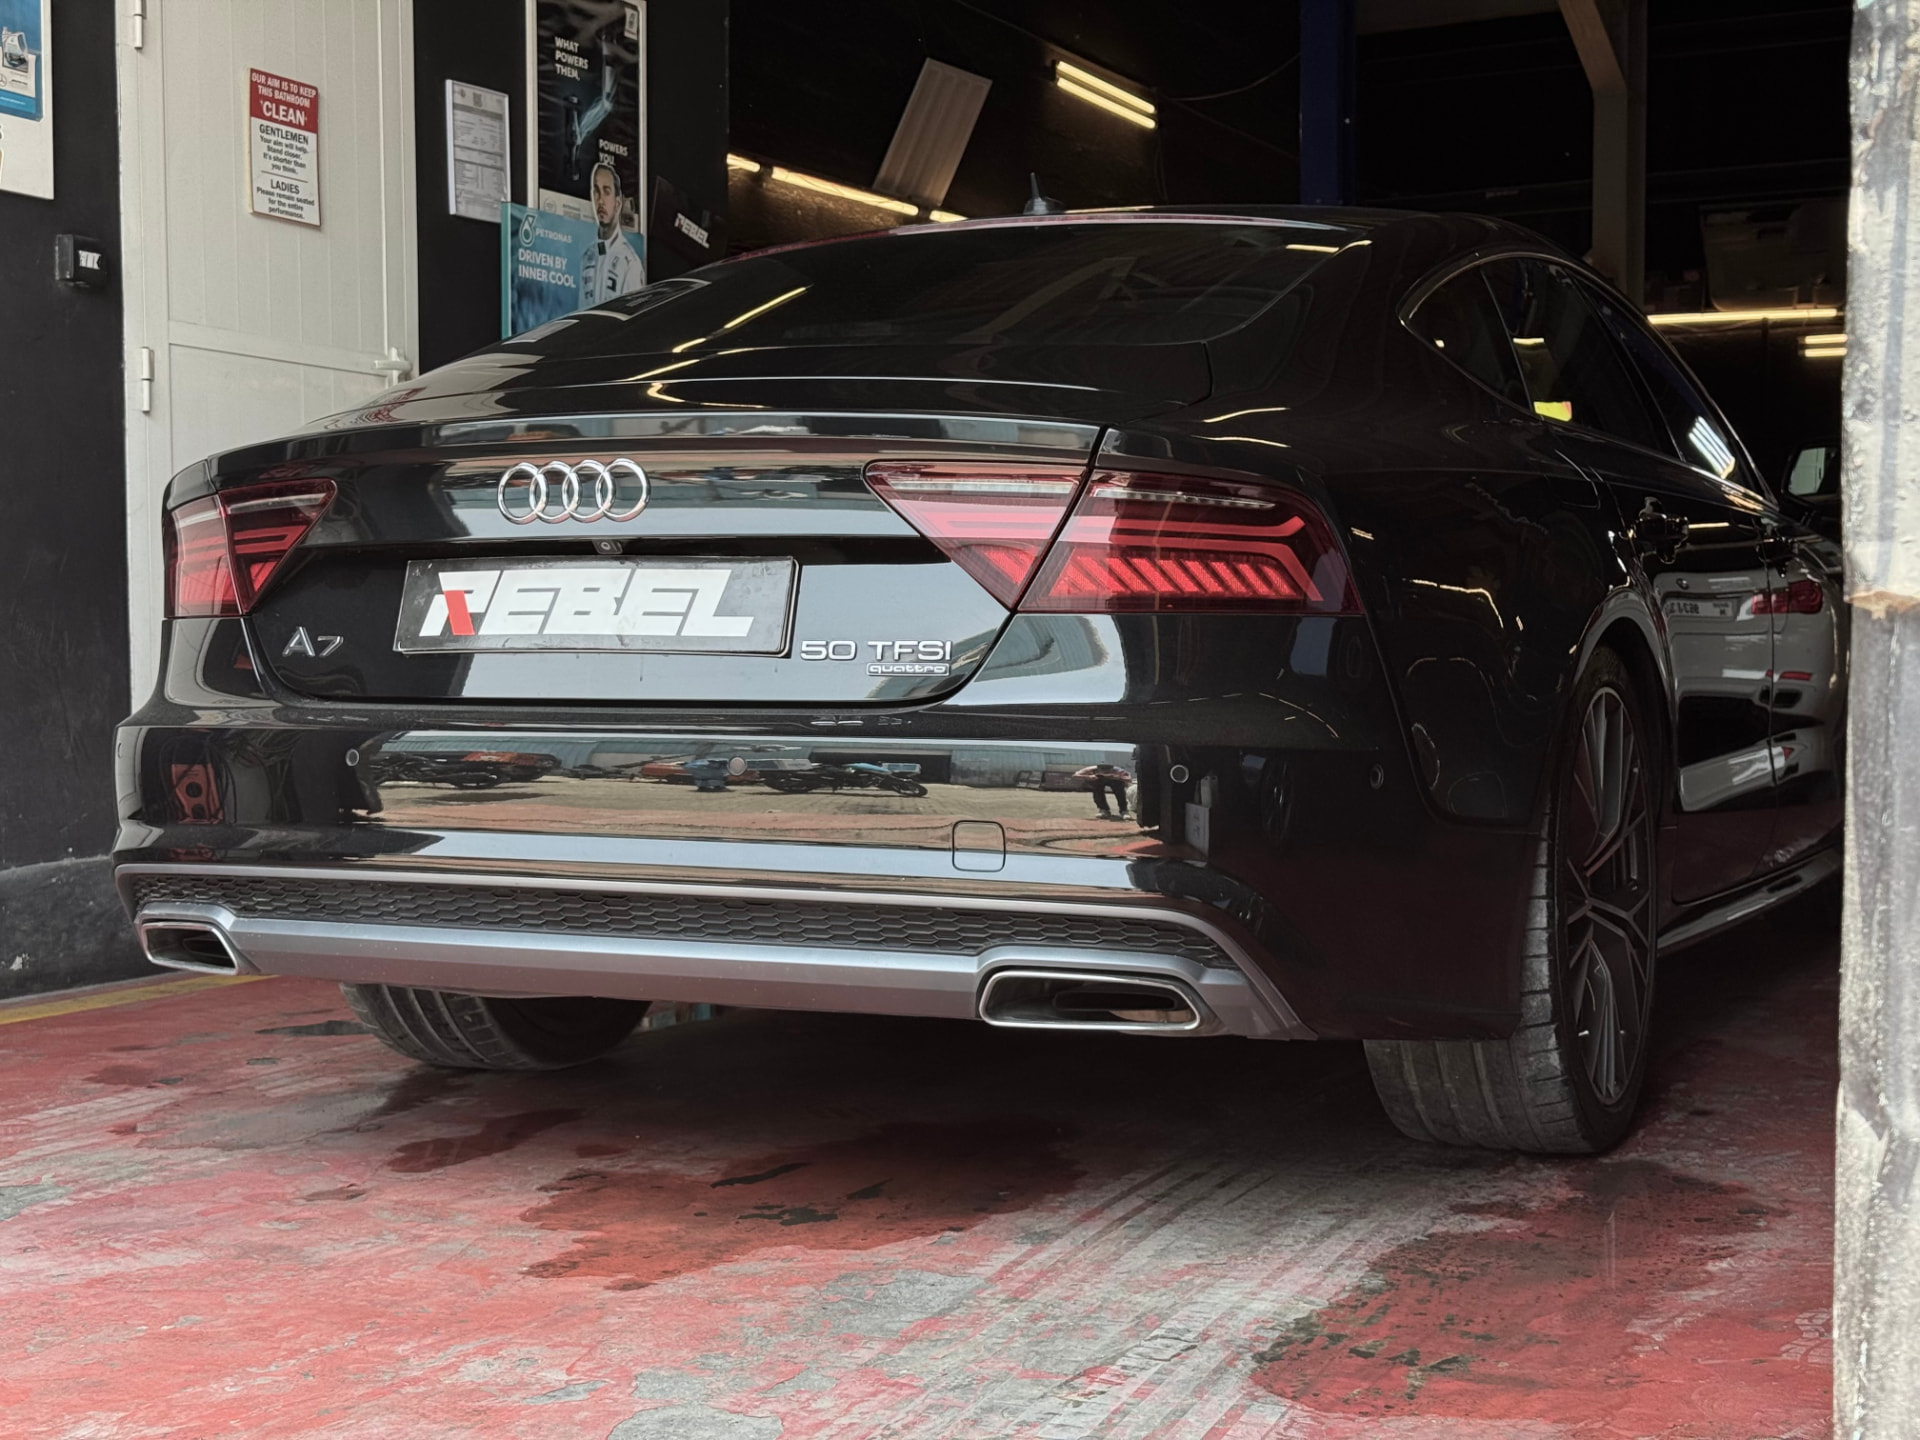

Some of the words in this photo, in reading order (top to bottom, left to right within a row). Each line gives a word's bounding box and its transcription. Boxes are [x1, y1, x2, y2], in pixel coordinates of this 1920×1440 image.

[555, 36, 579, 53] WHAT
[555, 50, 589, 70] POWERS
[251, 72, 266, 84] OUR
[267, 77, 280, 89] AIM
[281, 80, 289, 91] IS
[290, 83, 299, 94] TO
[300, 86, 317, 98] KEEP
[258, 84, 273, 98] THIS
[274, 90, 310, 109] BATHROOM
[259, 123, 309, 145] GENTLEMEN
[259, 135, 272, 144] Your
[273, 139, 283, 147] aim
[267, 144, 283, 155] Stand
[598, 138, 628, 157] POWERS
[263, 151, 272, 160] It's
[273, 155, 293, 165] shorter
[293, 159, 306, 169] than
[271, 163, 281, 171] you
[256, 186, 275, 196] Please
[276, 192, 295, 201] remain
[296, 197, 315, 206] seated
[270, 179, 300, 195] LADIES
[268, 197, 276, 205] for
[277, 199, 286, 208] the
[287, 203, 303, 212] entire
[535, 227, 573, 244] PETRONAS
[674, 212, 710, 249] REBEL
[518, 248, 554, 268] DRIVEN
[554, 256, 568, 271] BY
[518, 264, 549, 282] INNER
[549, 271, 577, 288] COOL
[418, 567, 755, 637] REBEL
[282, 626, 344, 657] A7
[800, 640, 857, 661] 50
[867, 640, 952, 661] TFSI
[869, 664, 946, 674] quattro
